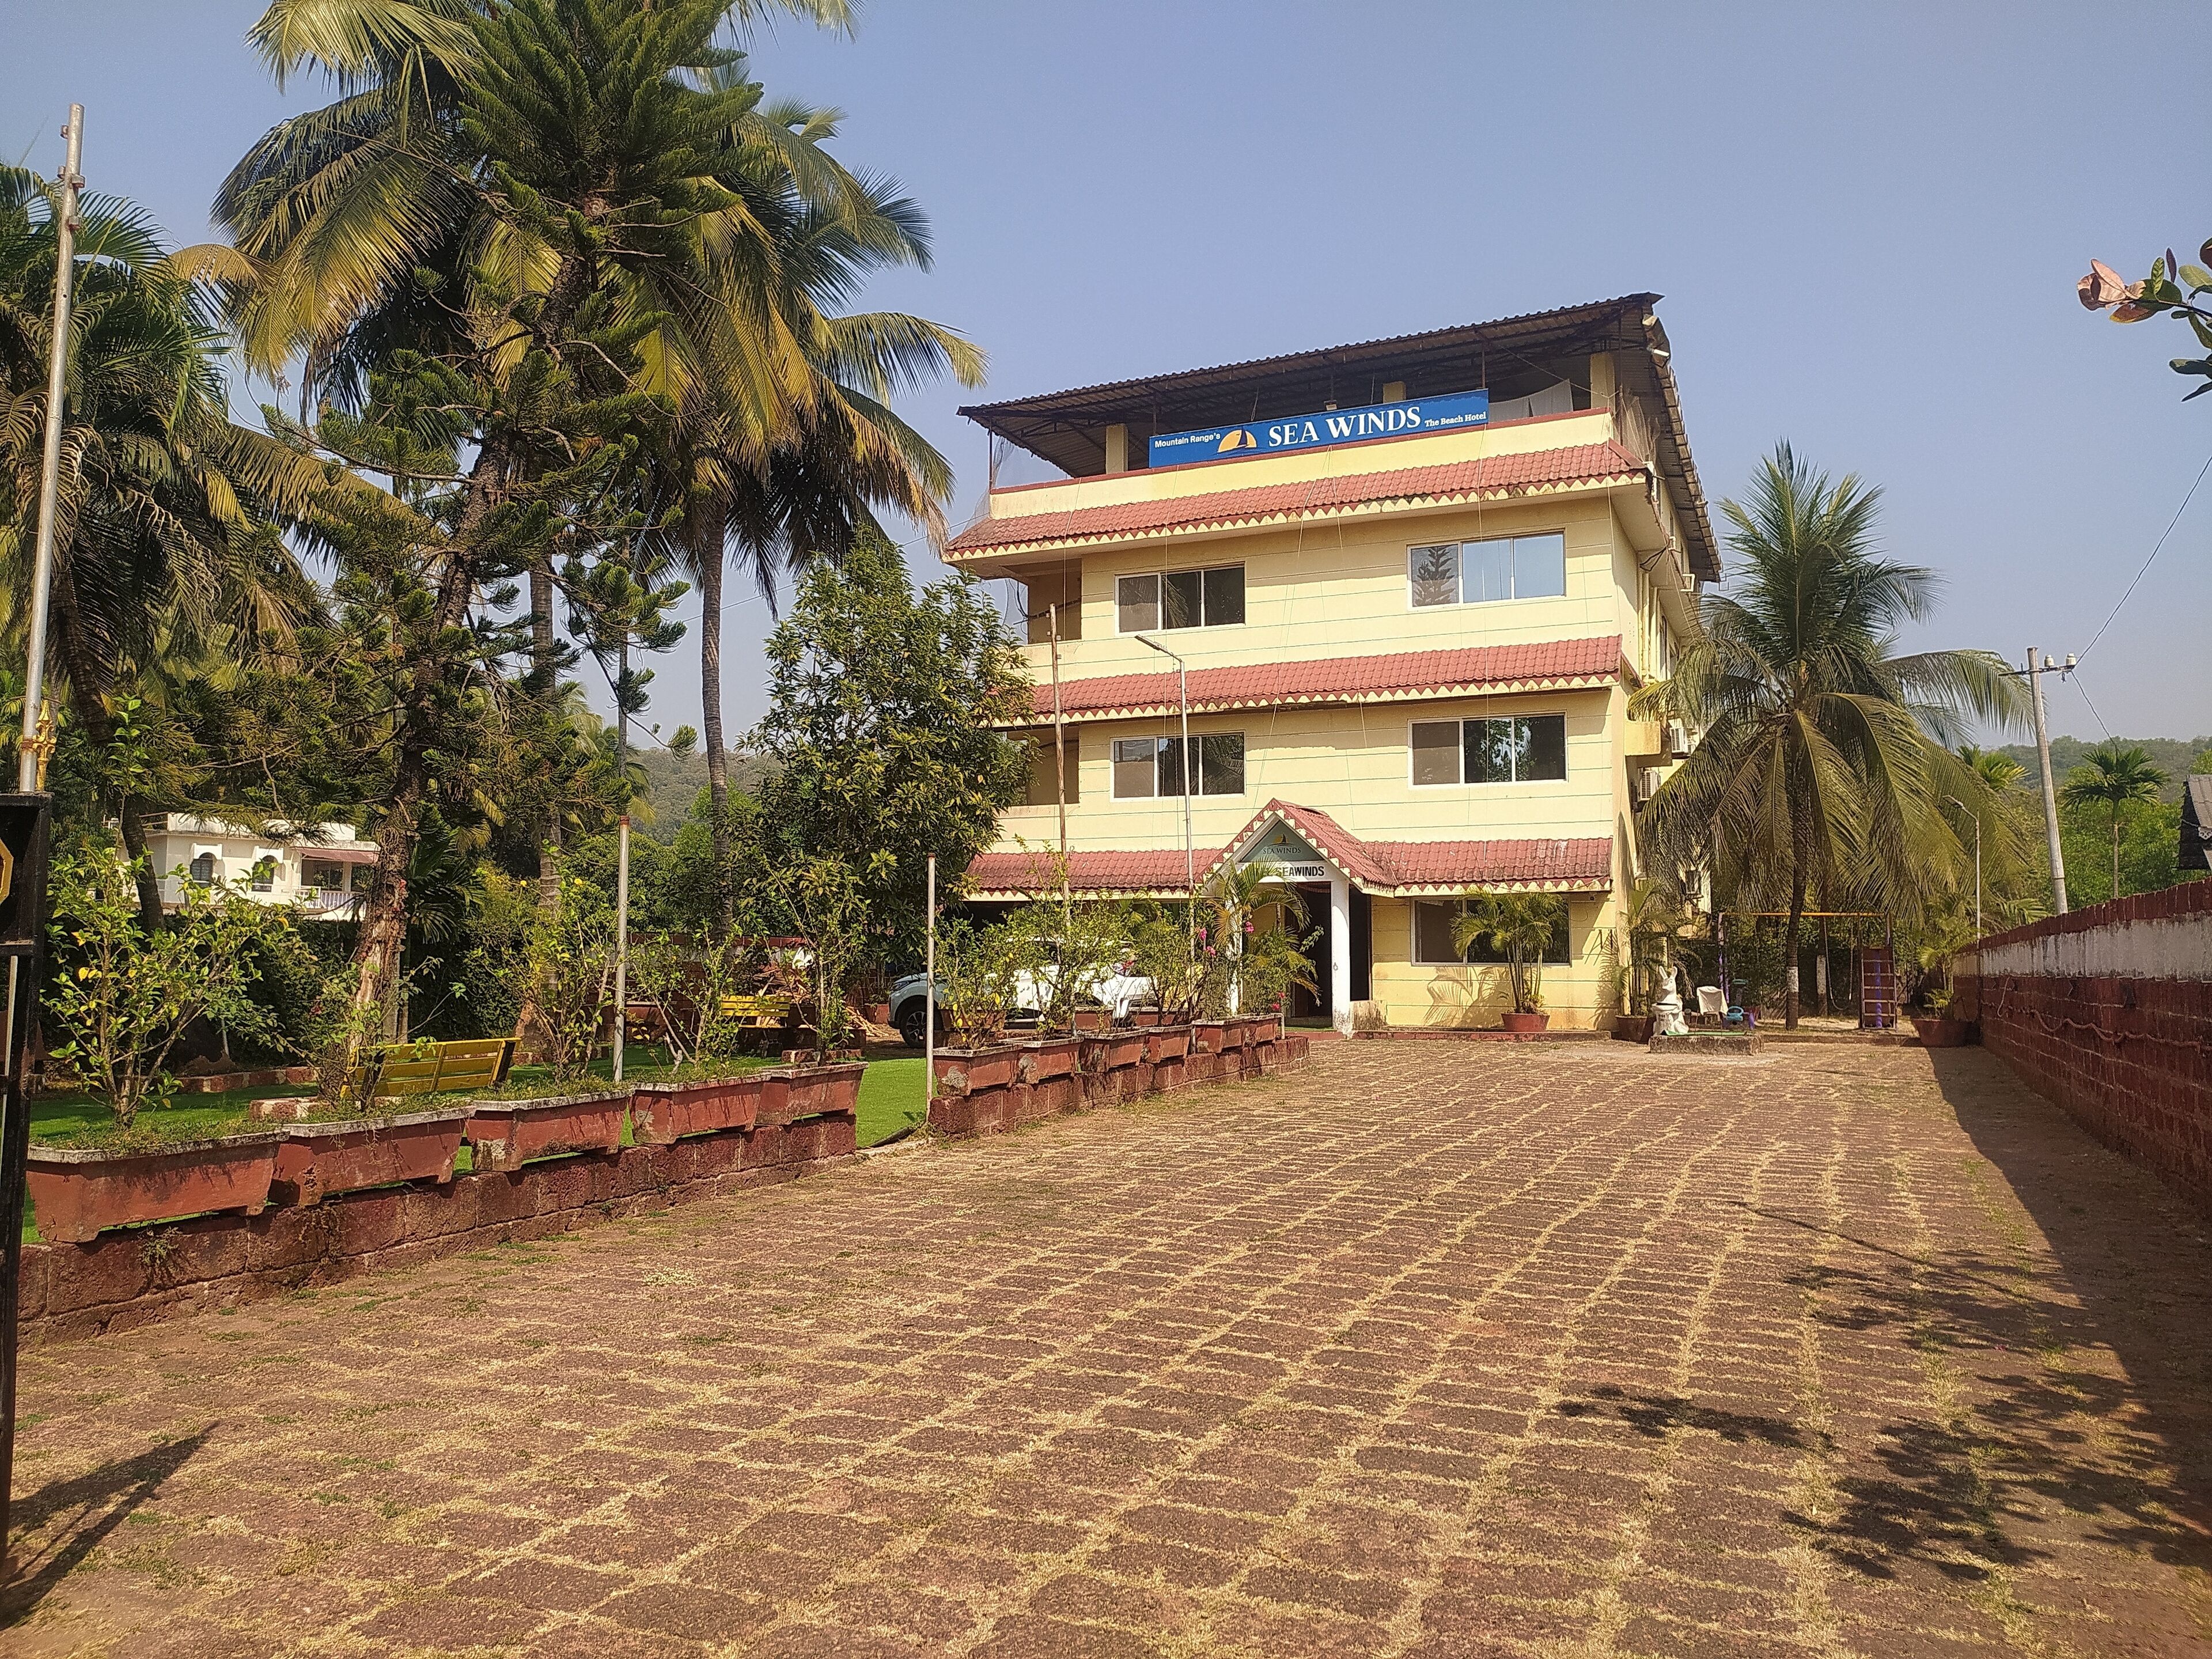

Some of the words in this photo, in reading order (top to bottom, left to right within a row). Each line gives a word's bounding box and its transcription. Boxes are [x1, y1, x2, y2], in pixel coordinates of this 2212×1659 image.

[1268, 421, 1320, 447] SEA
[1325, 407, 1421, 438] WINDS
[1424, 419, 1439, 427] The
[1440, 415, 1463, 425] Beach
[1464, 411, 1486, 422] Hotel
[1154, 437, 1189, 448] Mountain
[1190, 433, 1221, 443] Range's
